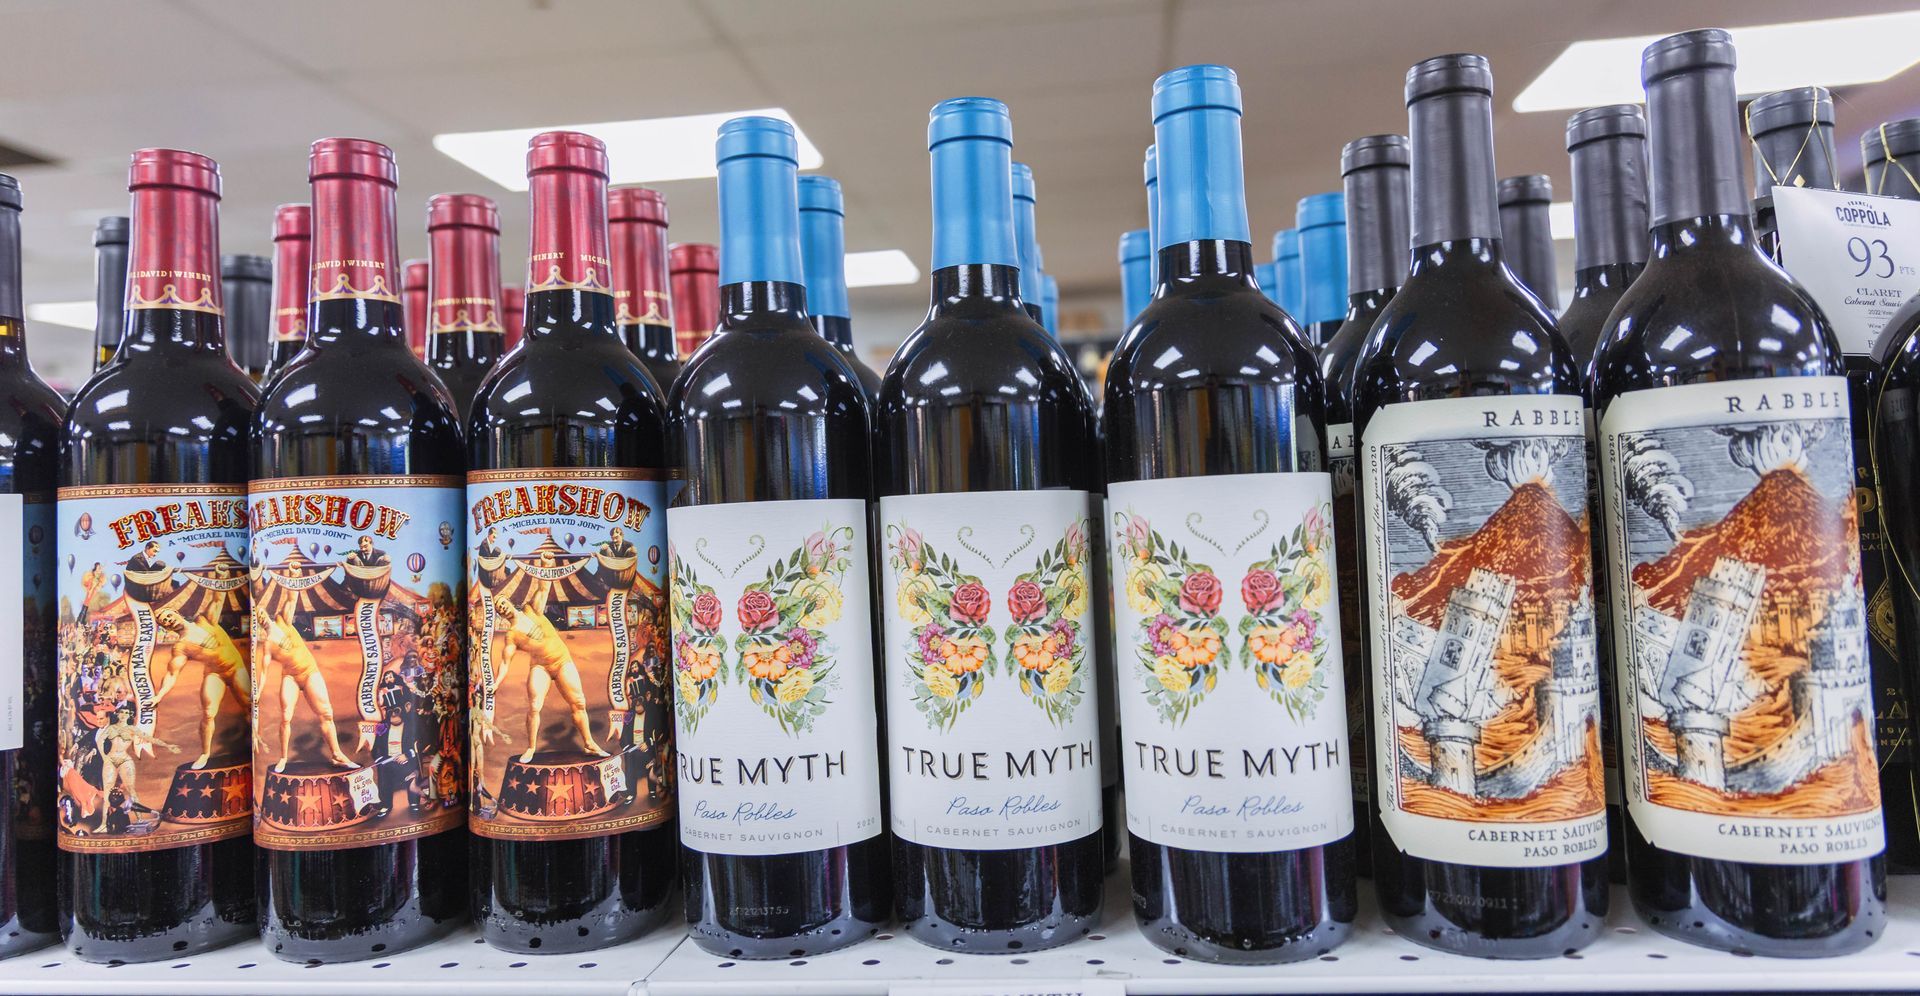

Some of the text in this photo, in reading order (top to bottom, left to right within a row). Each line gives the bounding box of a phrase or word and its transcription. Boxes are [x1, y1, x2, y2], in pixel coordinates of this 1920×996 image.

[1835, 206, 1892, 227] COPPOLA
[316, 259, 341, 270] DAVID
[347, 259, 386, 270] WINERY
[1847, 236, 1916, 279] 93 PTS
[140, 270, 168, 279] DAVID
[174, 270, 212, 282] WINERY
[1856, 287, 1903, 298] CLARET
[1725, 392, 1840, 413] RABBLE
[1482, 410, 1580, 428] RABBLE
[1608, 434, 1616, 464] 2020
[1370, 445, 1378, 475] 2020
[471, 484, 651, 535] FREAKSHOW
[296, 527, 321, 536] DAVID
[549, 517, 576, 526] DAVID
[168, 539, 177, 547] A
[1375, 535, 1383, 571] month
[484, 595, 494, 628] EARTH
[138, 609, 153, 642] EARTH
[131, 645, 145, 671] MAN
[360, 602, 378, 714] CABERNET SAUVIGNON
[609, 592, 627, 703] CABERNET SAUVIGNON
[361, 725, 375, 734] 2020
[676, 750, 847, 786] RUE MYTH
[902, 739, 1094, 781] TRUE MYTH
[1134, 738, 1340, 780] TRUE MYTH
[693, 800, 799, 826] Paso Robles
[946, 795, 1062, 820] Paso Robles
[1180, 795, 1305, 822] Paso Robles
[685, 826, 733, 841] CABERNET
[740, 828, 823, 842] SAUVIGNON
[926, 819, 1081, 837] CABERNET SAUVIGNON
[1160, 822, 1327, 839] CABERNET SAUVIGNON
[1468, 829, 1558, 843] CABERNET
[1718, 823, 1819, 838] CABERNET
[1524, 837, 1598, 858] PASO ROBLES
[1780, 837, 1868, 854] PASO ROBLES
